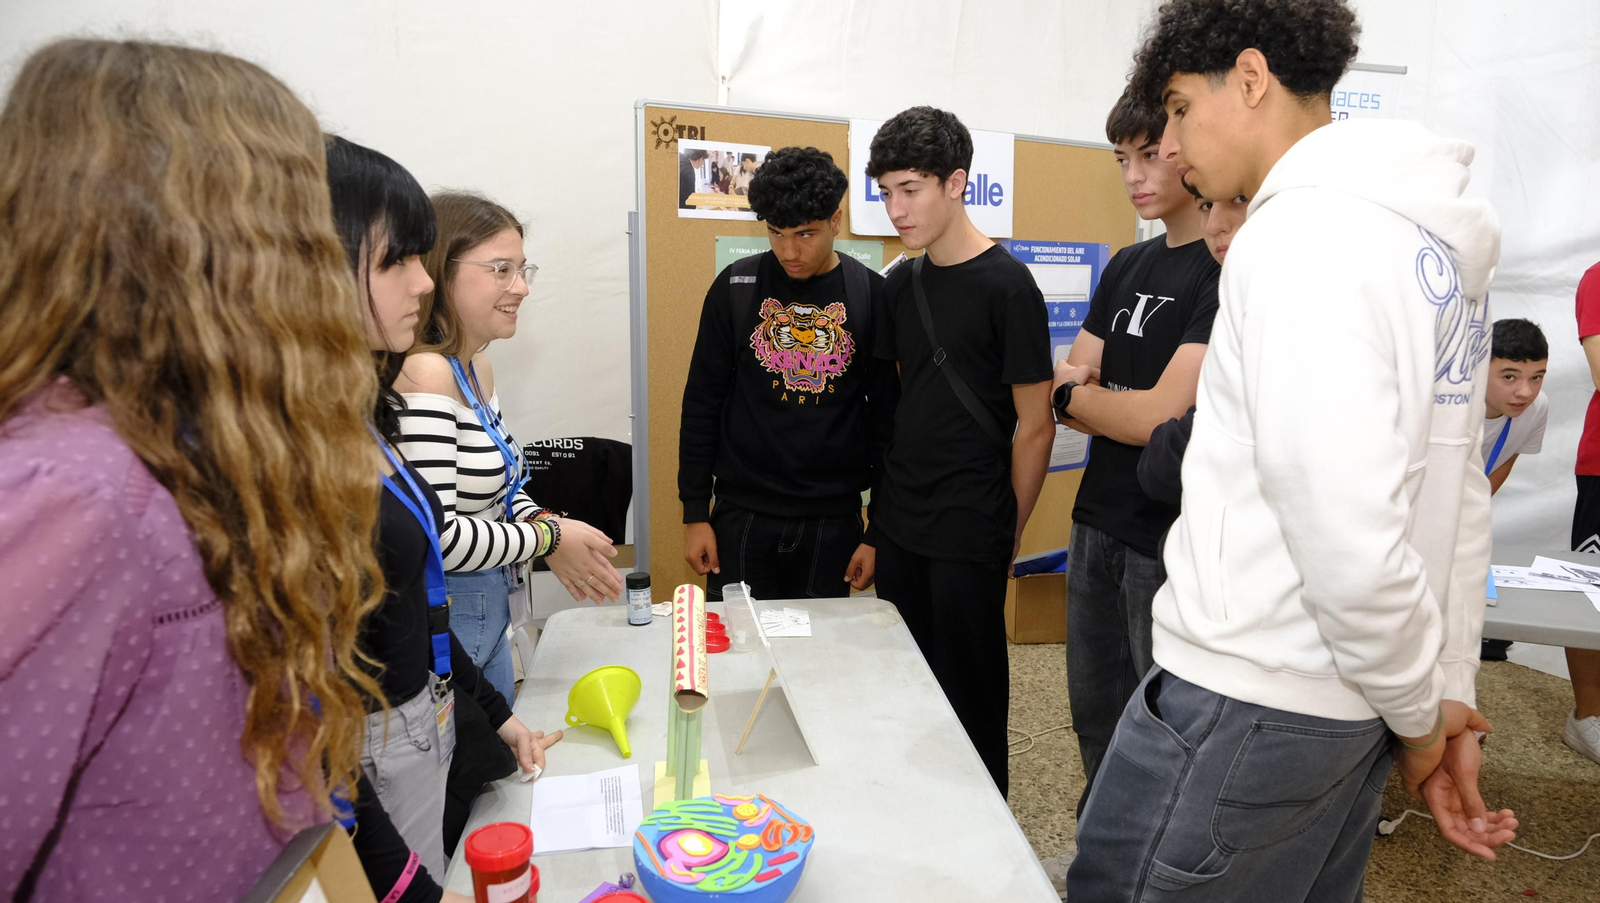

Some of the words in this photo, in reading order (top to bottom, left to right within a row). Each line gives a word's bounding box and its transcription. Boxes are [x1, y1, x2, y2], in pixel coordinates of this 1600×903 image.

[865, 173, 887, 202] L
[964, 173, 1004, 207] alle
[1030, 245, 1067, 254] FUNCIONAMIENTO
[1067, 247, 1075, 255] DEL
[1075, 247, 1085, 255] AIRE
[1034, 254, 1067, 263] ACONDICIONADO
[1067, 255, 1081, 263] SOLAR
[770, 350, 843, 373] KENZO
[1433, 393, 1471, 405] OSTON
